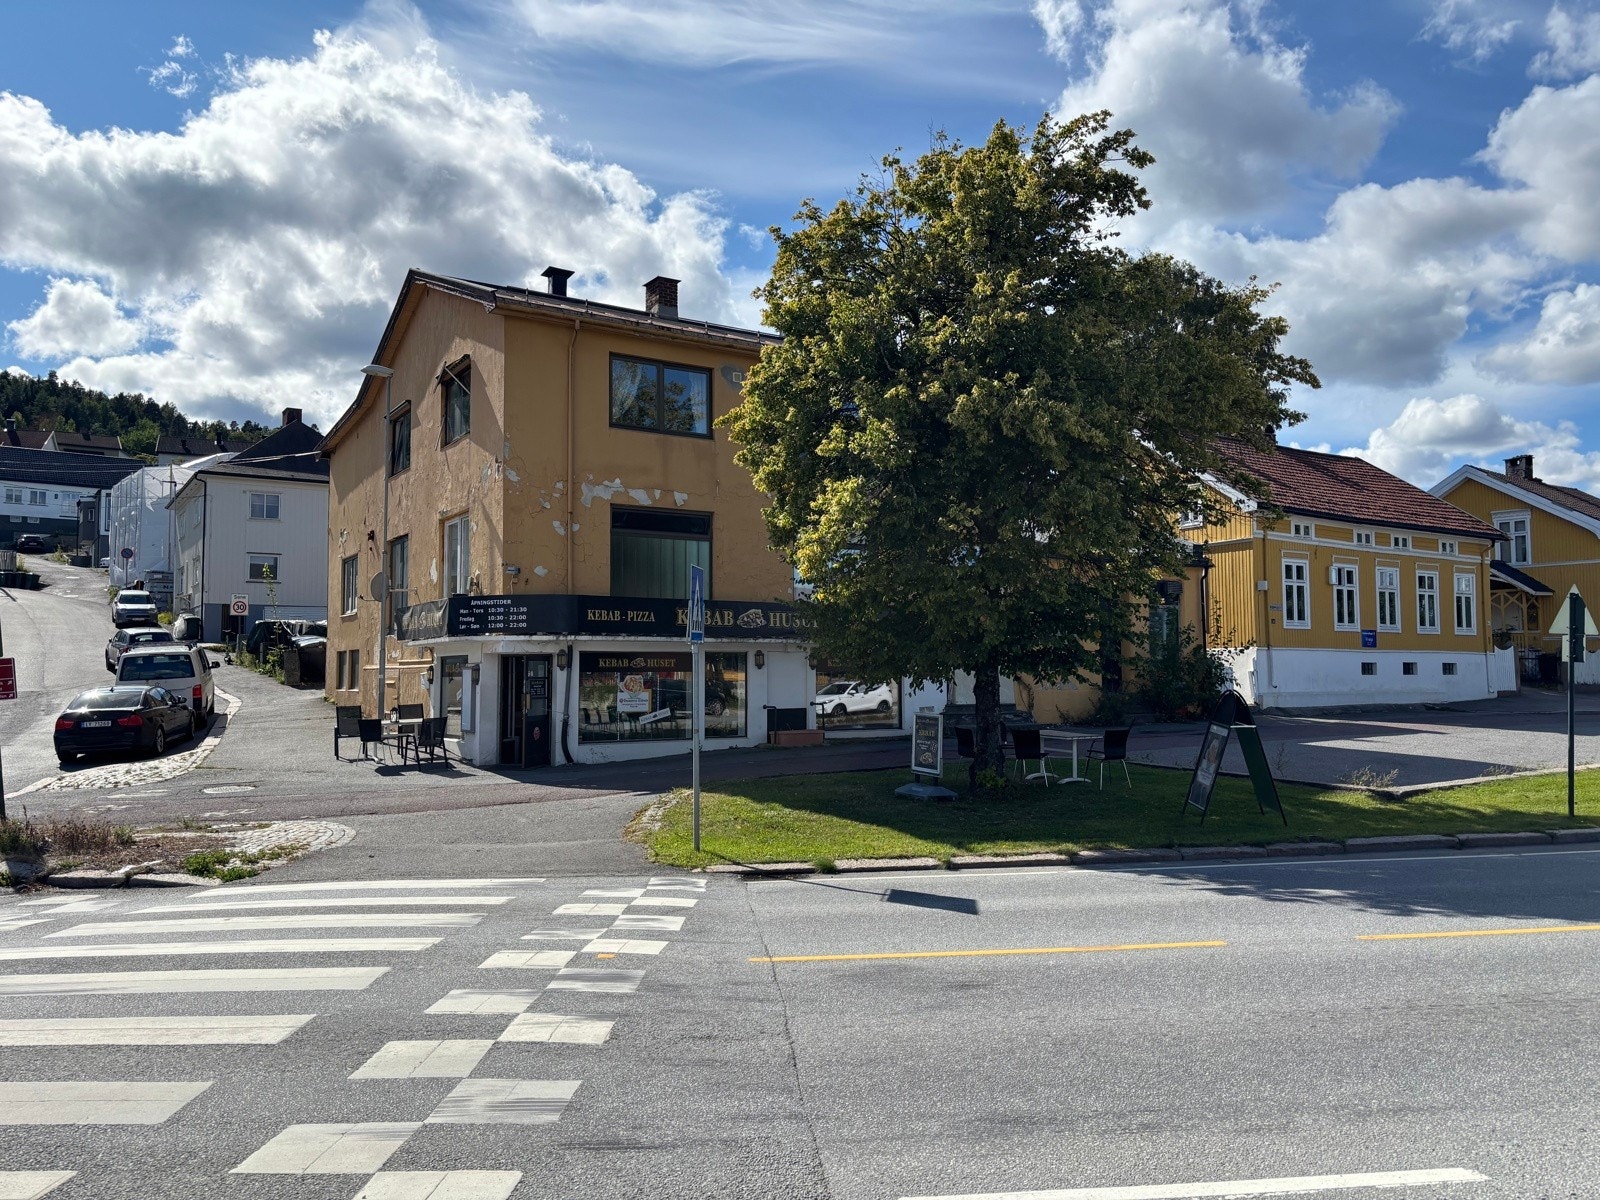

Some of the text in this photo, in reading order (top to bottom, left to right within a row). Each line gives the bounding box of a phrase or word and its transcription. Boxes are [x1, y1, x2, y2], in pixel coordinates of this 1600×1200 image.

[587, 608, 621, 621] KEBAB
[627, 610, 655, 622] PIZZA
[676, 608, 733, 626] KBAB
[599, 658, 676, 667] KEBAB HUSET
